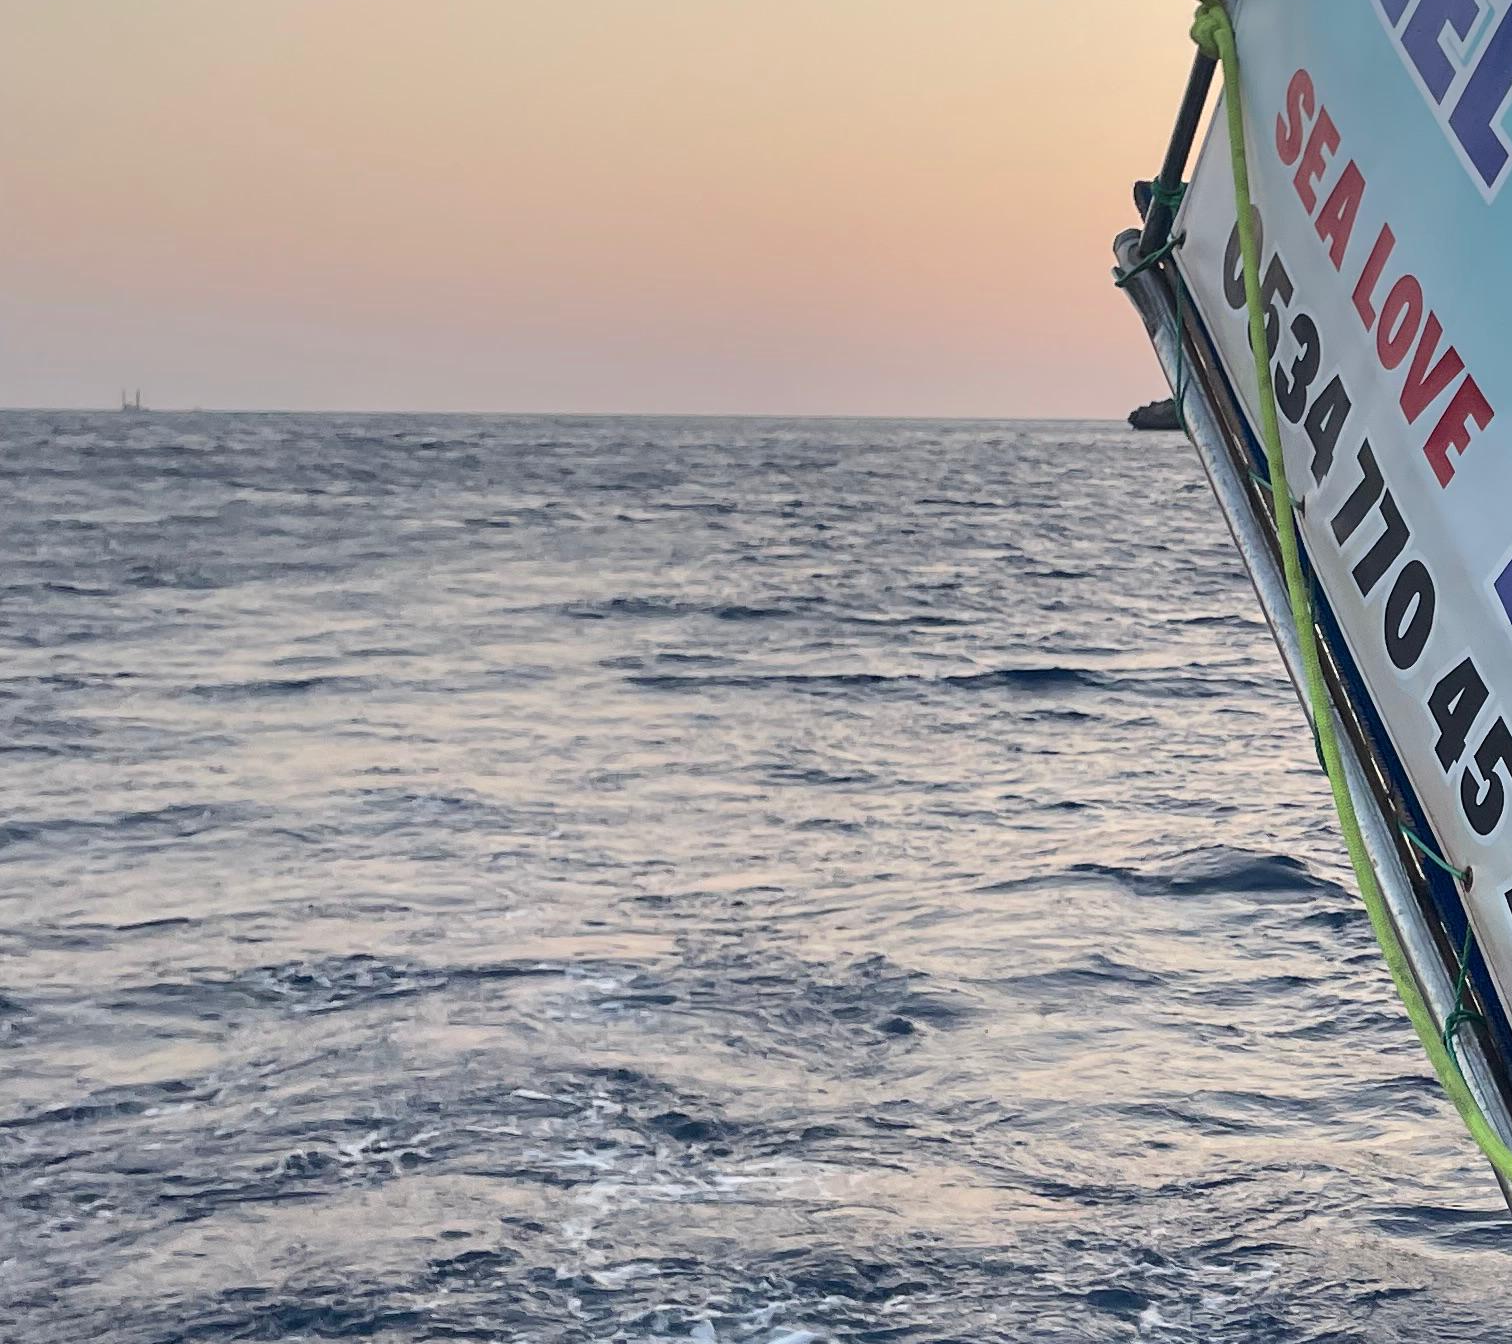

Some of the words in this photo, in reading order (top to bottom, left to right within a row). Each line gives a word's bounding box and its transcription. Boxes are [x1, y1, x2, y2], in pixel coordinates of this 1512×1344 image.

[1274, 68, 1368, 272] SEA
[1351, 222, 1495, 489] LOVE
[1330, 436, 1436, 670] 770
